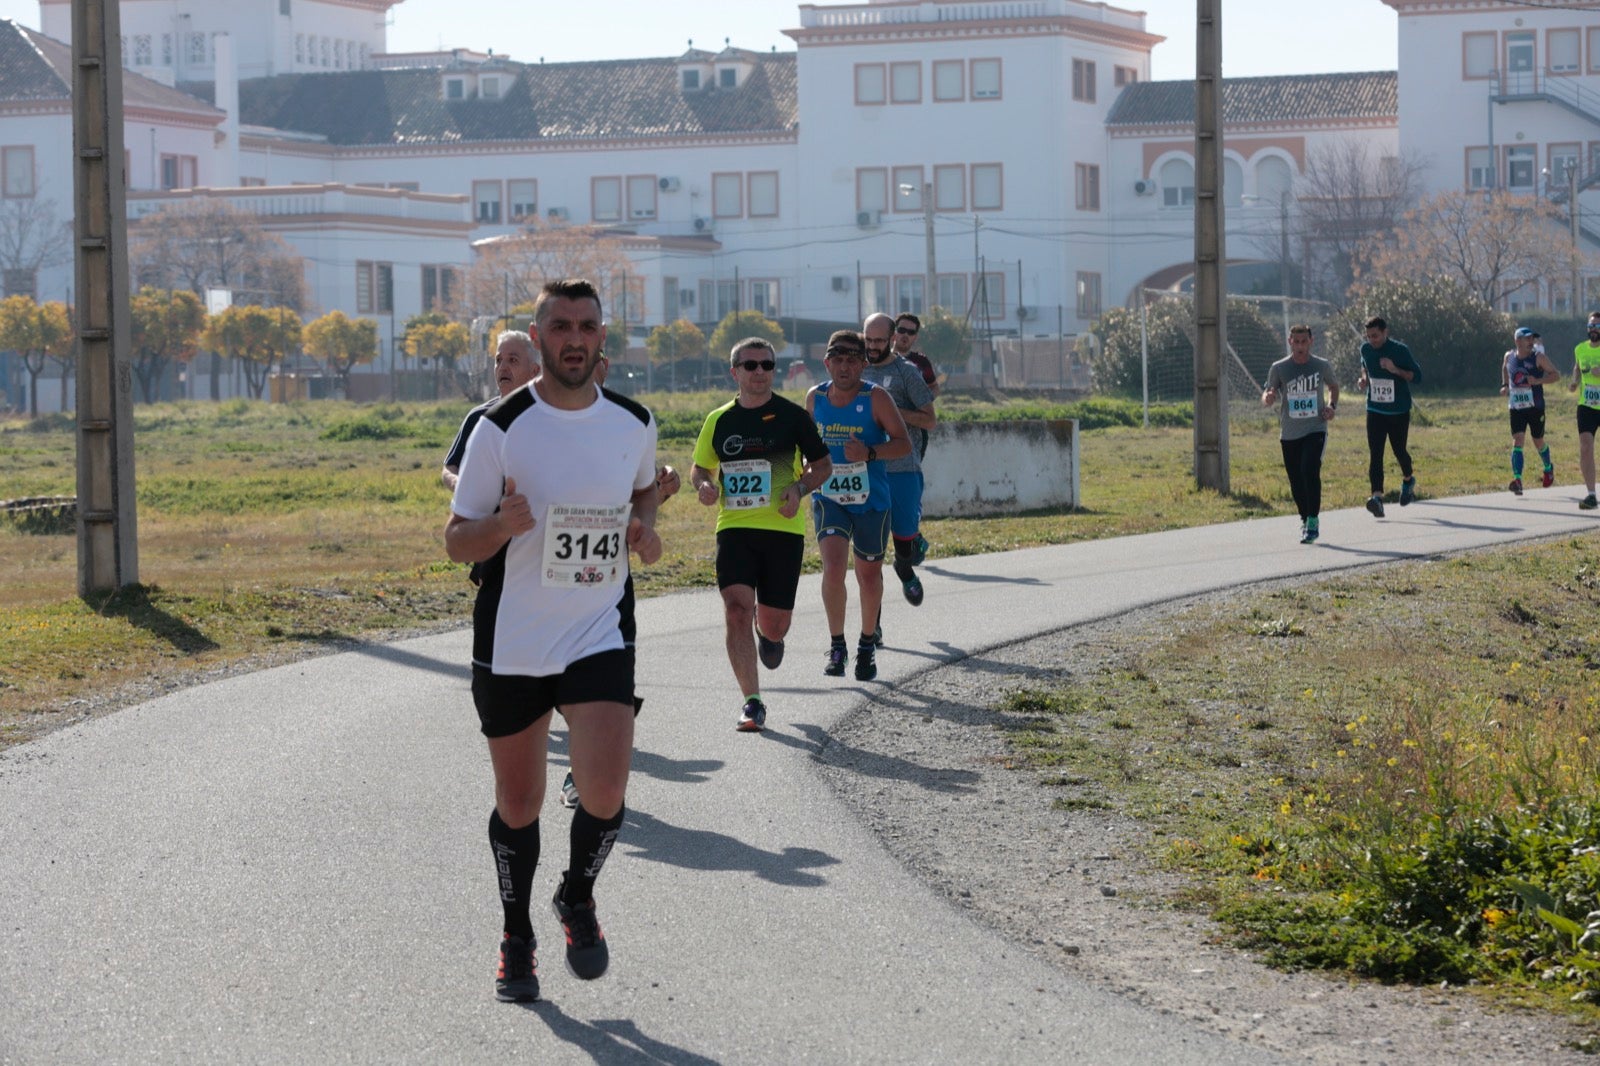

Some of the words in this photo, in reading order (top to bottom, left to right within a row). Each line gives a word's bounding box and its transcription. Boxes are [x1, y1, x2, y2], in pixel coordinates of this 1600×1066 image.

[1585, 390, 1600, 399] 109
[1294, 399, 1313, 410] 864
[825, 423, 864, 434] olimpo
[729, 475, 762, 494] 322
[829, 476, 862, 492] 448
[555, 532, 619, 560] 3143
